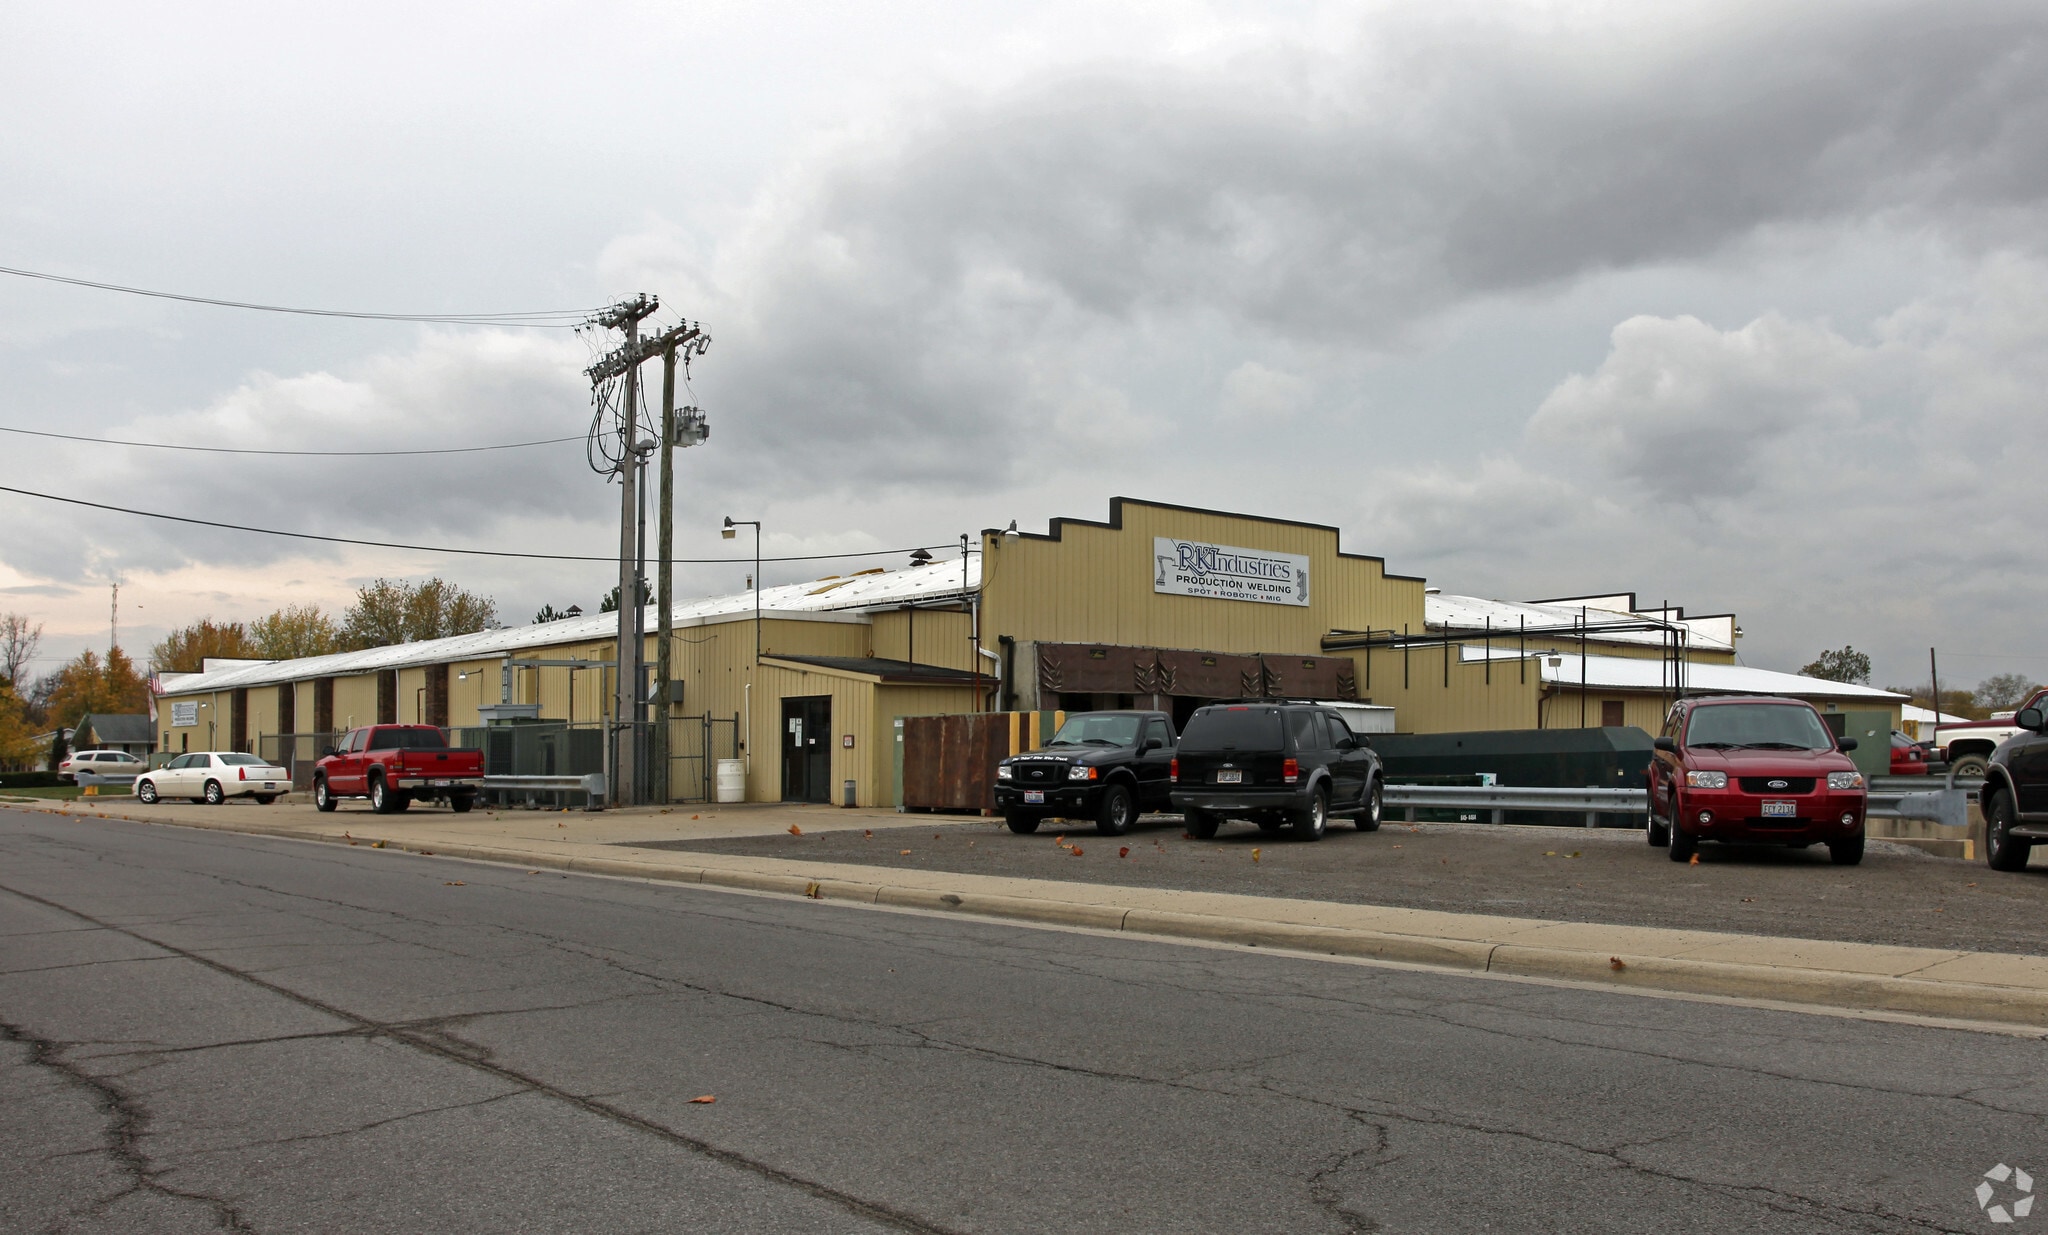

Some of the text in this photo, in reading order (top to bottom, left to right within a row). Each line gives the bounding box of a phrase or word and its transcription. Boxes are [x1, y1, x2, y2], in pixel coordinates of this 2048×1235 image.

[1176, 575, 1292, 594] PRODUCTION WELDING
[1187, 587, 1211, 595] SPOT
[1220, 591, 1258, 600] ROBOTIC
